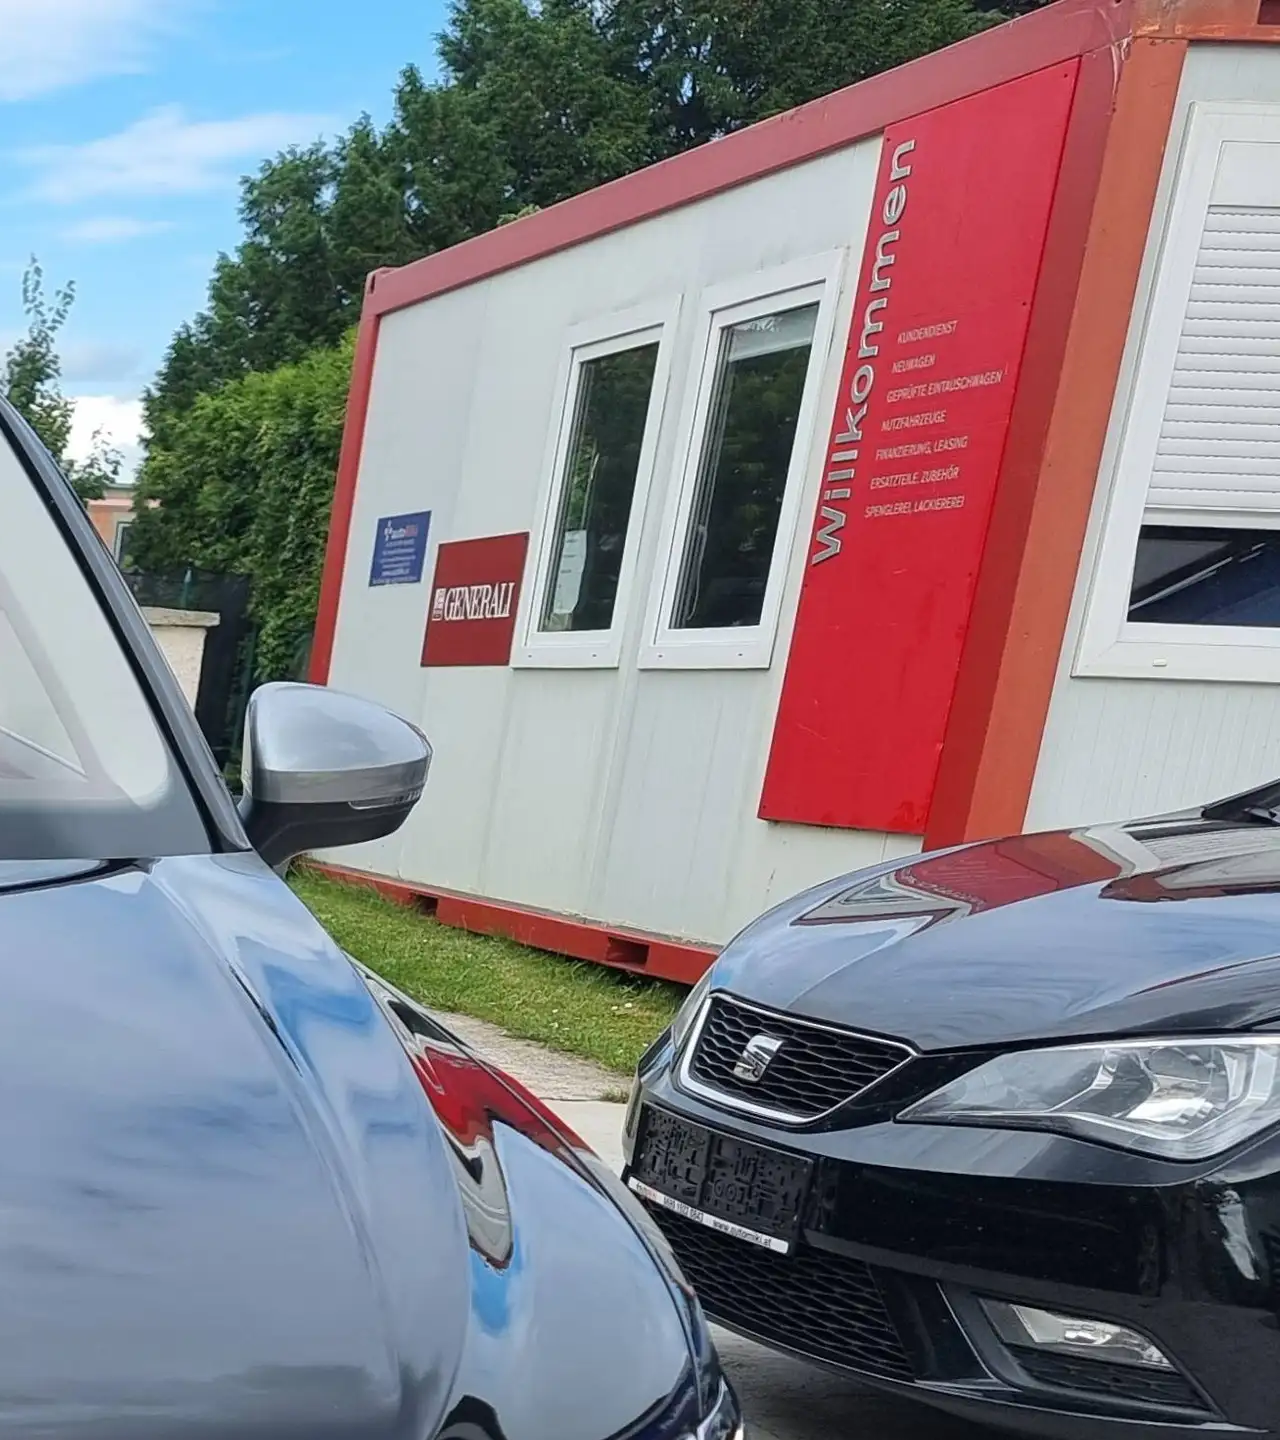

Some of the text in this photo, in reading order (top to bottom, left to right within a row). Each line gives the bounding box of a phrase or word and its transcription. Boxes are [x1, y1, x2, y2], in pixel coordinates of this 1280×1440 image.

[897, 320, 958, 344] KUNDENDIENST
[812, 138, 915, 565] Willkommen
[891, 354, 936, 373] NEUWAGEN
[886, 370, 1003, 402] GEPRÜFTE EINTAUSCHWAGEN
[881, 409, 947, 431] NUTZFAHRZEUGE
[933, 435, 968, 452] LEASING
[920, 463, 960, 484] ZUBEHÖR
[914, 495, 966, 513] LACKIEREREI
[444, 582, 516, 621] GENERALI
